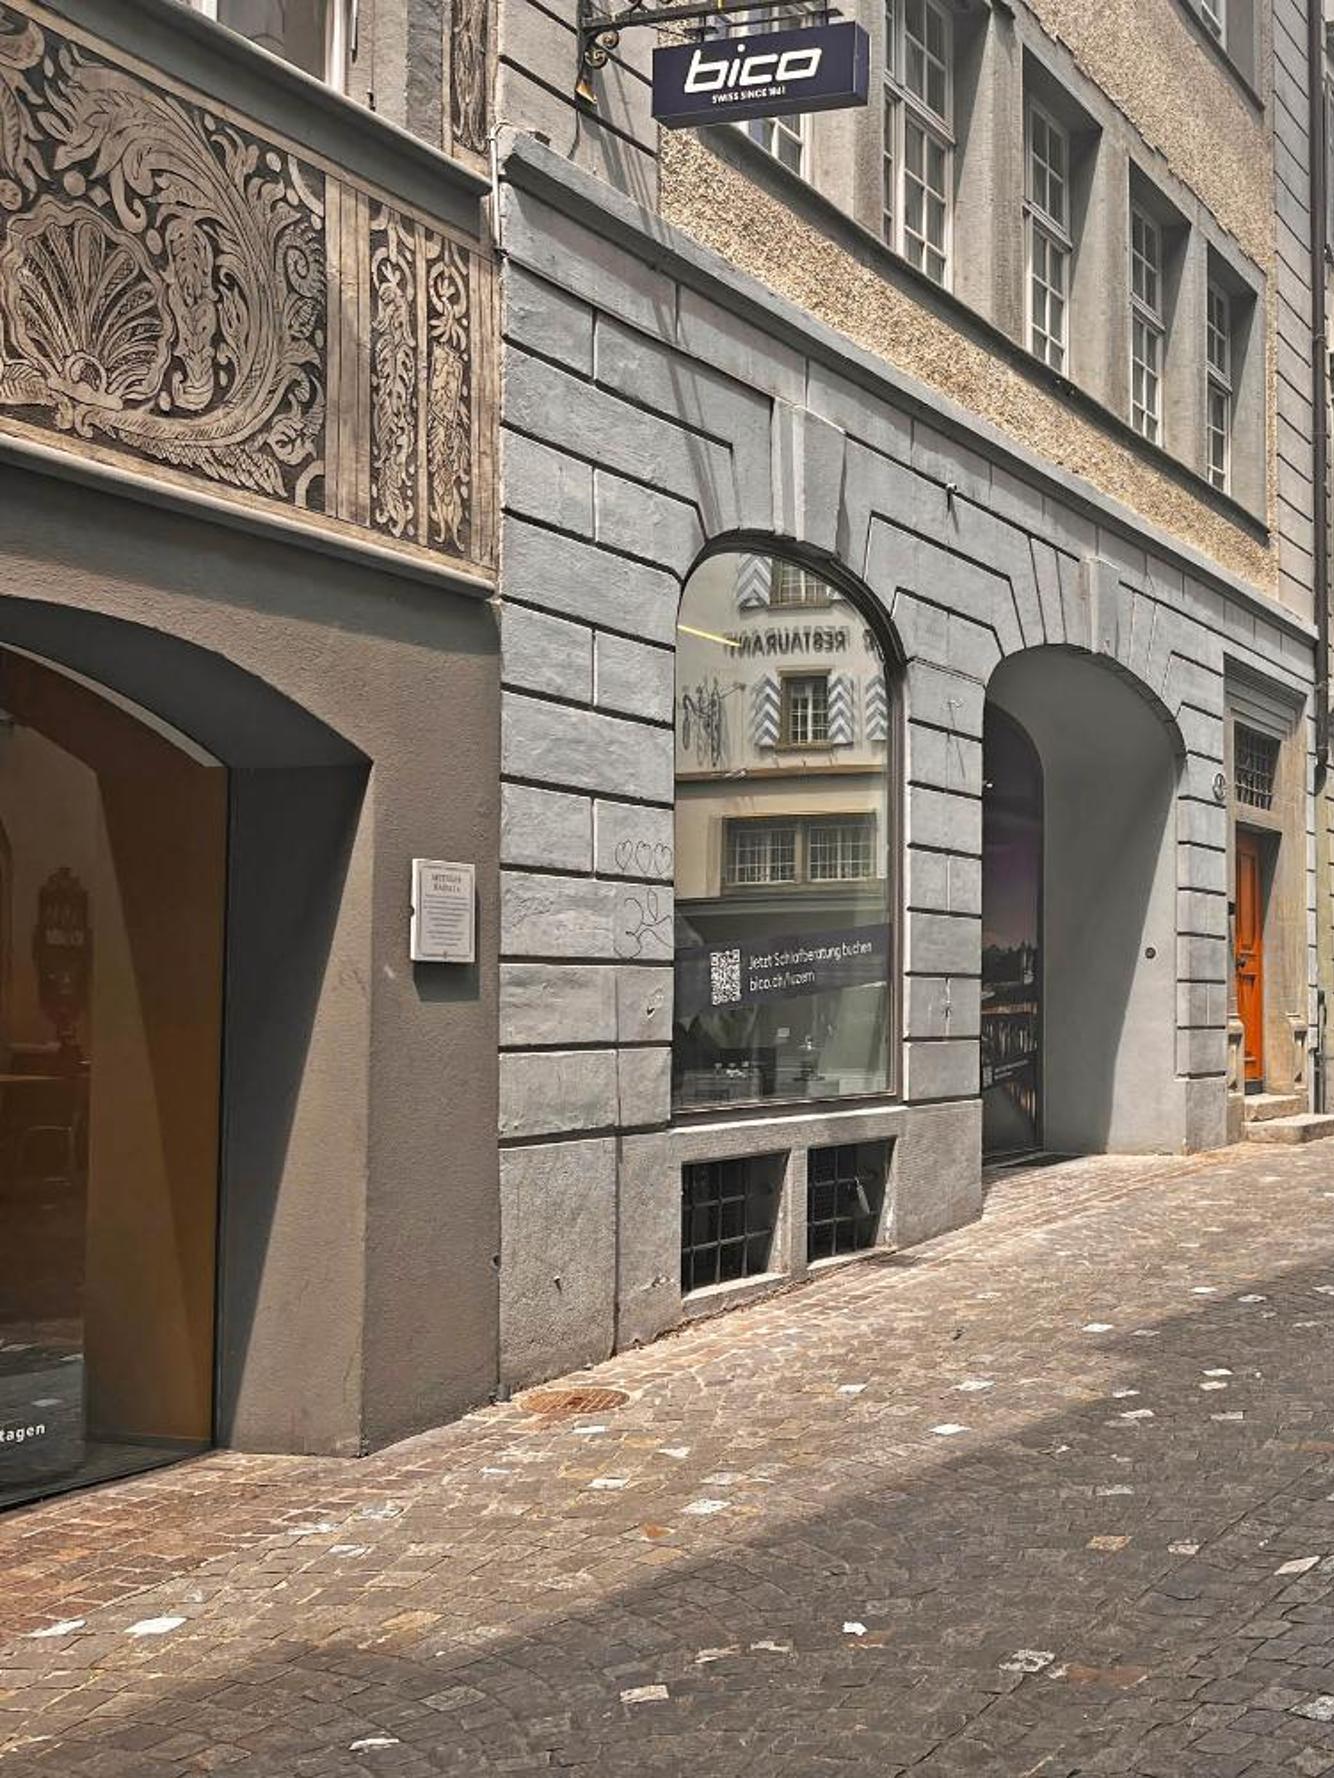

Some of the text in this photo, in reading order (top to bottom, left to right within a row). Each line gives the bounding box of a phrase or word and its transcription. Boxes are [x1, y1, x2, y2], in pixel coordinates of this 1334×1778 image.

[684, 44, 822, 93] bico
[712, 91, 739, 104] SWISS
[740, 87, 768, 100] SINCE
[748, 941, 873, 970] Jetzt Schlafberatung buchen
